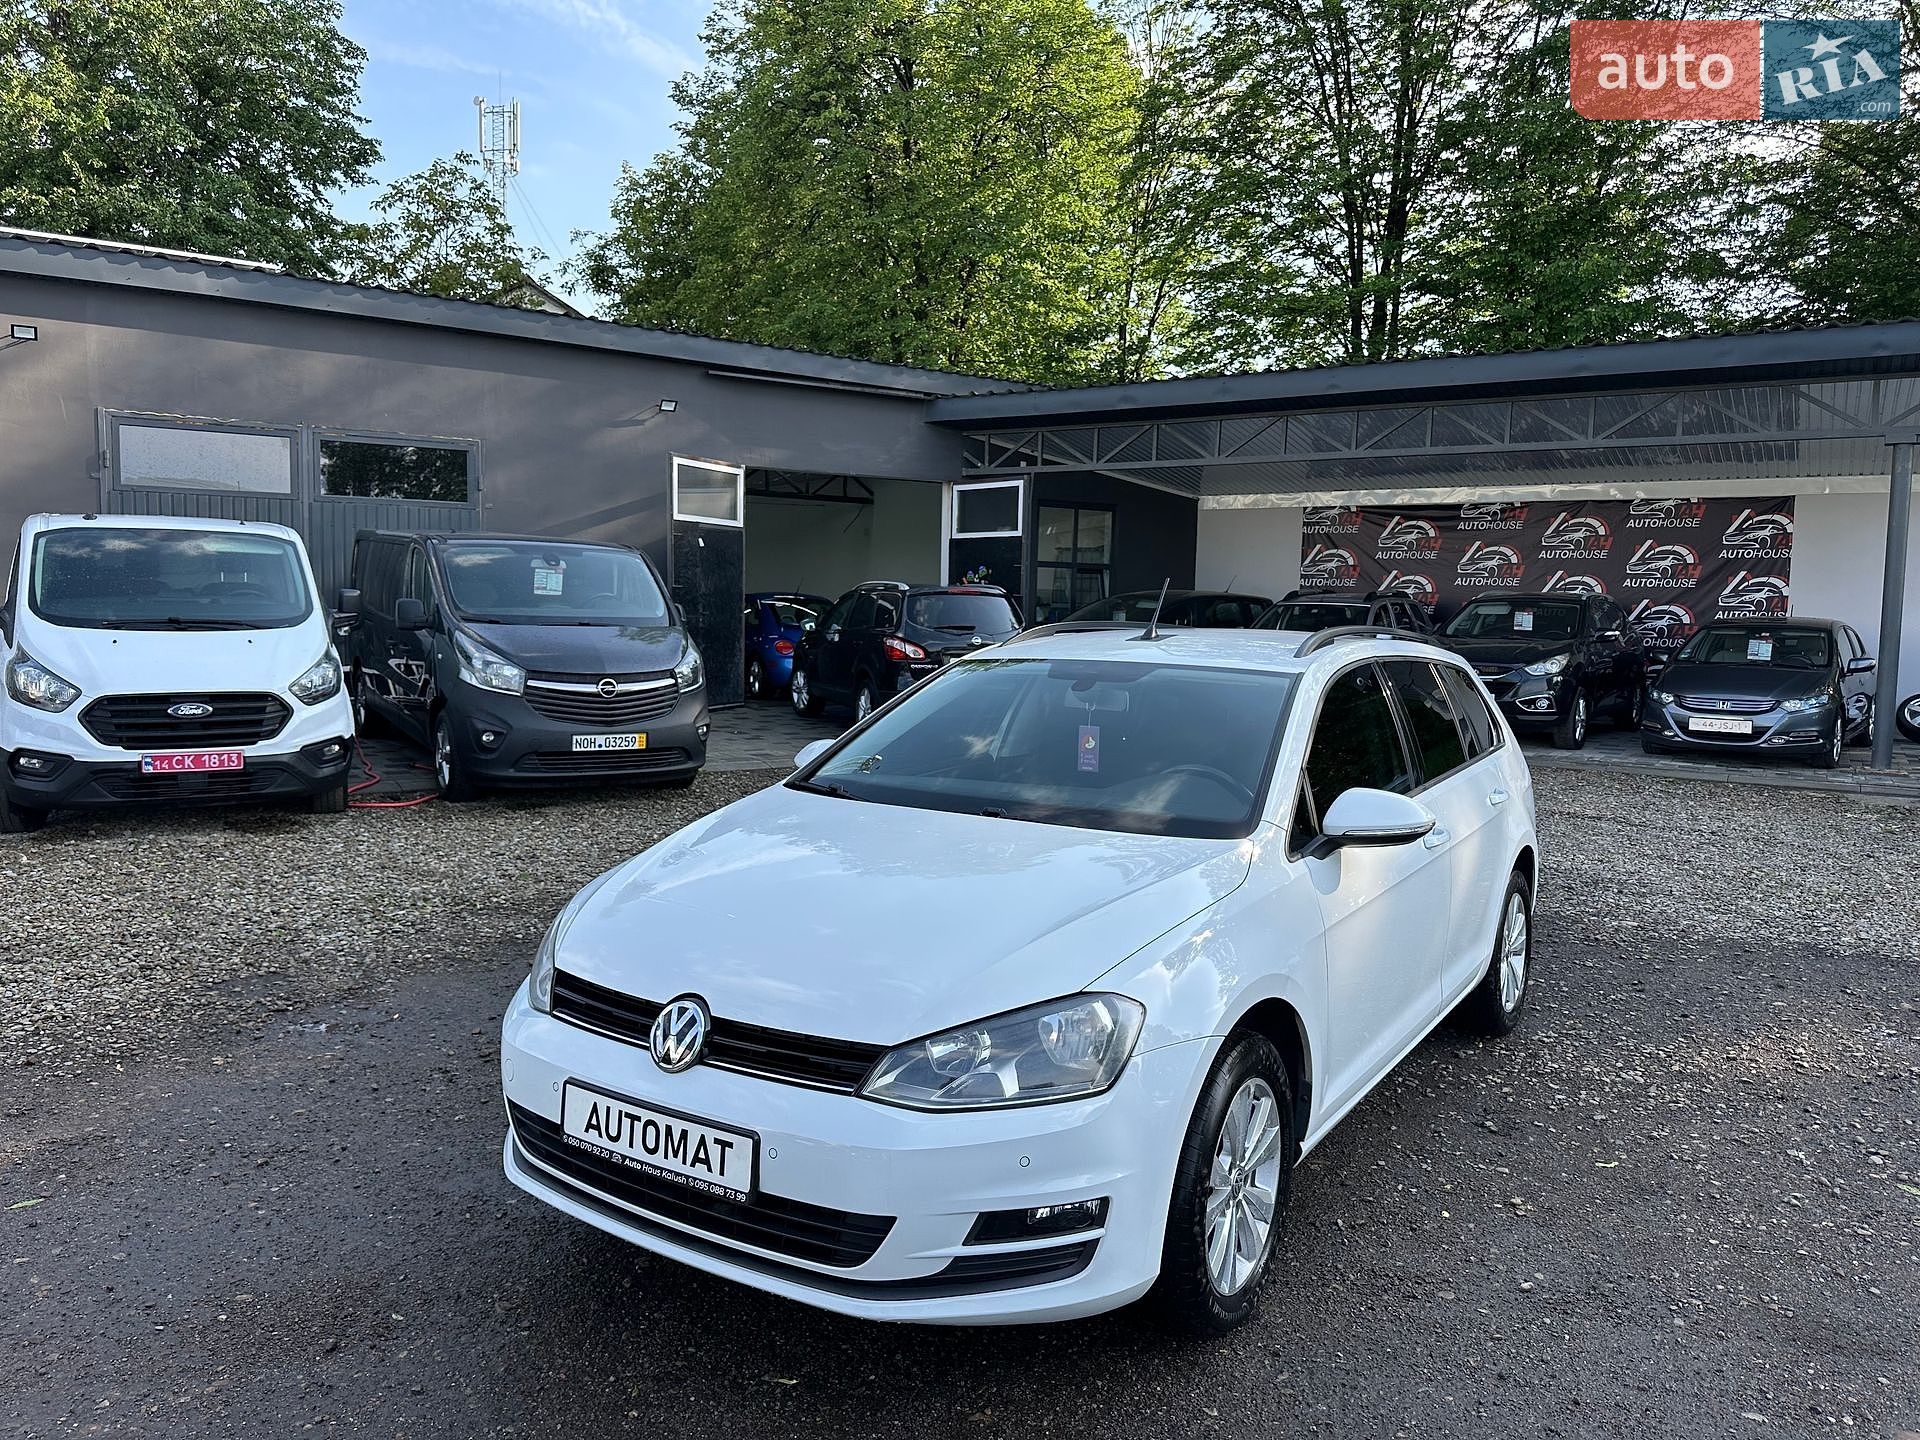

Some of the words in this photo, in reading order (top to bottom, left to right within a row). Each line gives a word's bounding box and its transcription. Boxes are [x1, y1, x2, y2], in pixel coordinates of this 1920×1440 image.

[1457, 520, 1524, 529] AUTOHOUSE
[1626, 518, 1701, 527] AUTOHOUSE
[1302, 525, 1359, 534] AUTOHOUSE
[1375, 550, 1438, 559] AUTOHOUSE
[1538, 550, 1609, 559] AUTOHOUSE
[1454, 577, 1521, 586] AUTOHOUSE
[1622, 578, 1698, 588] AUTOHOUSE
[1714, 610, 1787, 619] AUTOHOUS
[178, 705, 203, 715] Ford
[604, 736, 637, 748] 03259
[172, 756, 195, 769] CK
[201, 753, 238, 768] 1813
[584, 1101, 734, 1176] AUTOMAT
[624, 1158, 641, 1170] Auto
[642, 1163, 661, 1176] Haus
[662, 1170, 687, 1185] Kalush
[694, 1180, 709, 1191] 095
[725, 1189, 735, 1199] 73
